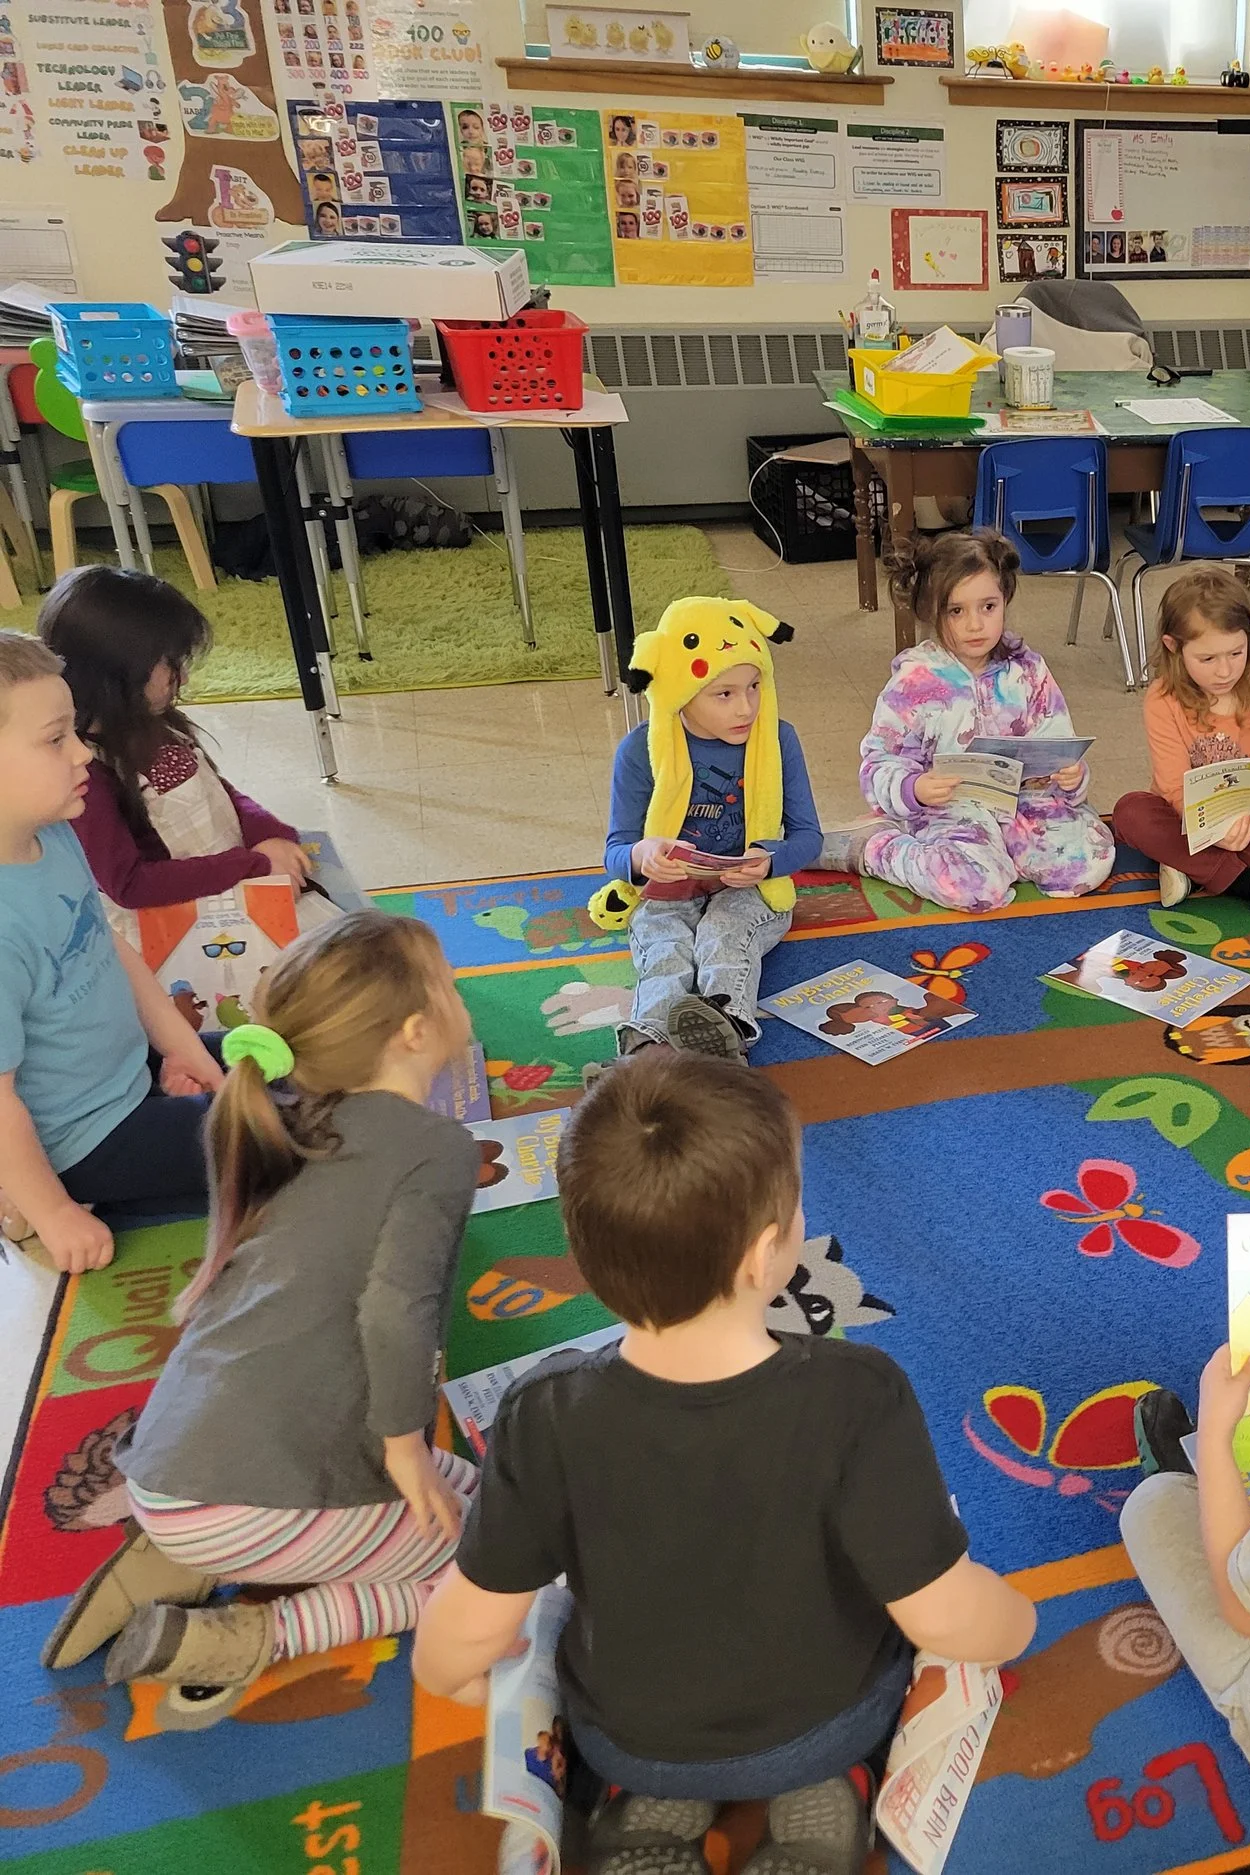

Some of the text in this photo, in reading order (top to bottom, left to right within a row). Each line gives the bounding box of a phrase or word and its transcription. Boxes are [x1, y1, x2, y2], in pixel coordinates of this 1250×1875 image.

[28, 14, 132, 28] SUBSTITUTE LEADER
[37, 63, 116, 76] TECHNOLOGY
[330, 70, 349, 80] 400
[58, 81, 103, 93] LEADER
[89, 98, 136, 112] LEADER
[49, 118, 104, 128] COMMUNITY
[772, 117, 797, 126] Discipline
[77, 131, 111, 141] LEADER
[1151, 132, 1173, 148] Emily
[63, 145, 128, 160] CLEAN UP
[74, 164, 126, 178] LEADER
[772, 966, 866, 1010] My Brother
[808, 976, 873, 1007] Charlie
[1157, 975, 1211, 1006] Charlie
[1170, 971, 1244, 1018] My Brother
[515, 1135, 546, 1186] Charlie
[469, 1278, 545, 1318] 10
[62, 1266, 184, 1382] Quail
[947, 1724, 982, 1785] COOL
[1085, 1741, 1245, 1844] Log
[922, 1782, 958, 1850] BEAN
